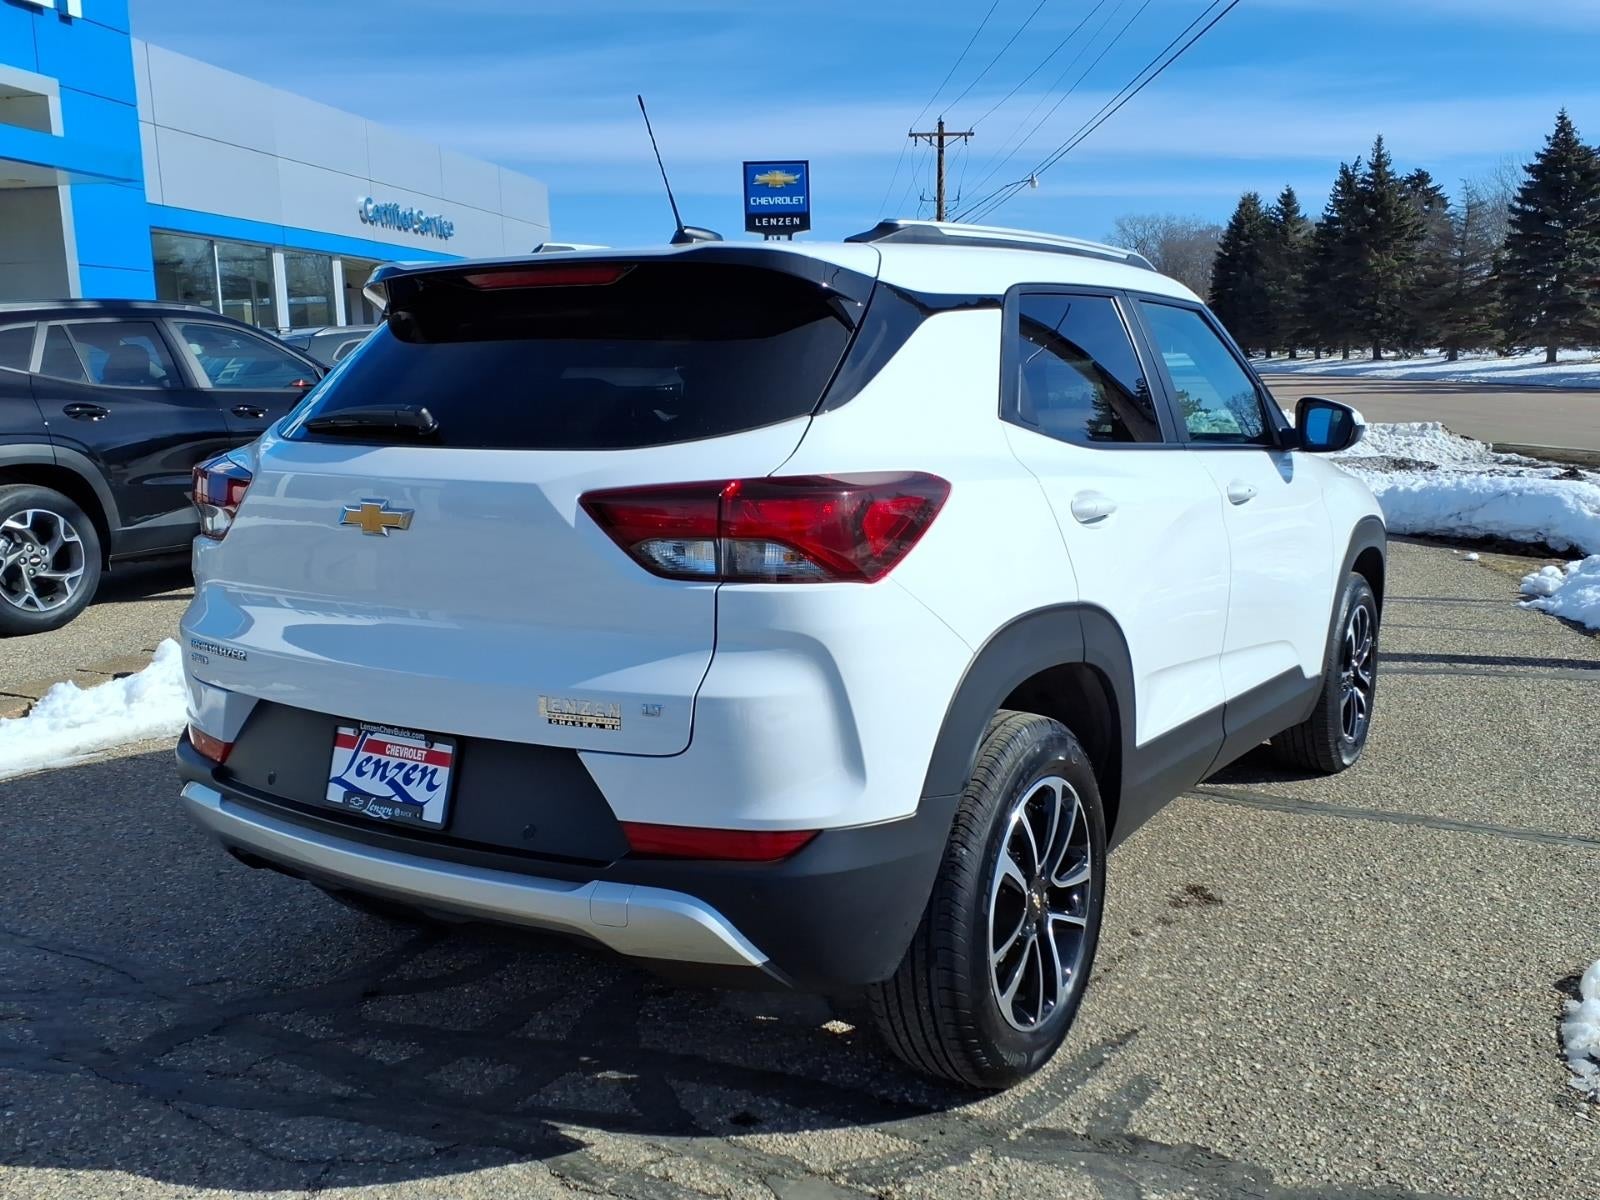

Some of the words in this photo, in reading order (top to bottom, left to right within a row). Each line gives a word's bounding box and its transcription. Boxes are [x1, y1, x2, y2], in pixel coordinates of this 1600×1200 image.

[750, 196, 804, 206] CHEVROLET
[361, 197, 414, 231] Certified
[414, 210, 454, 239] Service
[755, 217, 800, 226] LENZEN
[538, 695, 621, 719] LENZEN
[360, 722, 425, 741] LenzenChevBuick.com
[385, 744, 427, 761] CHEVROLET
[328, 730, 443, 807] Lenzen
[362, 797, 393, 819] Lenzen
